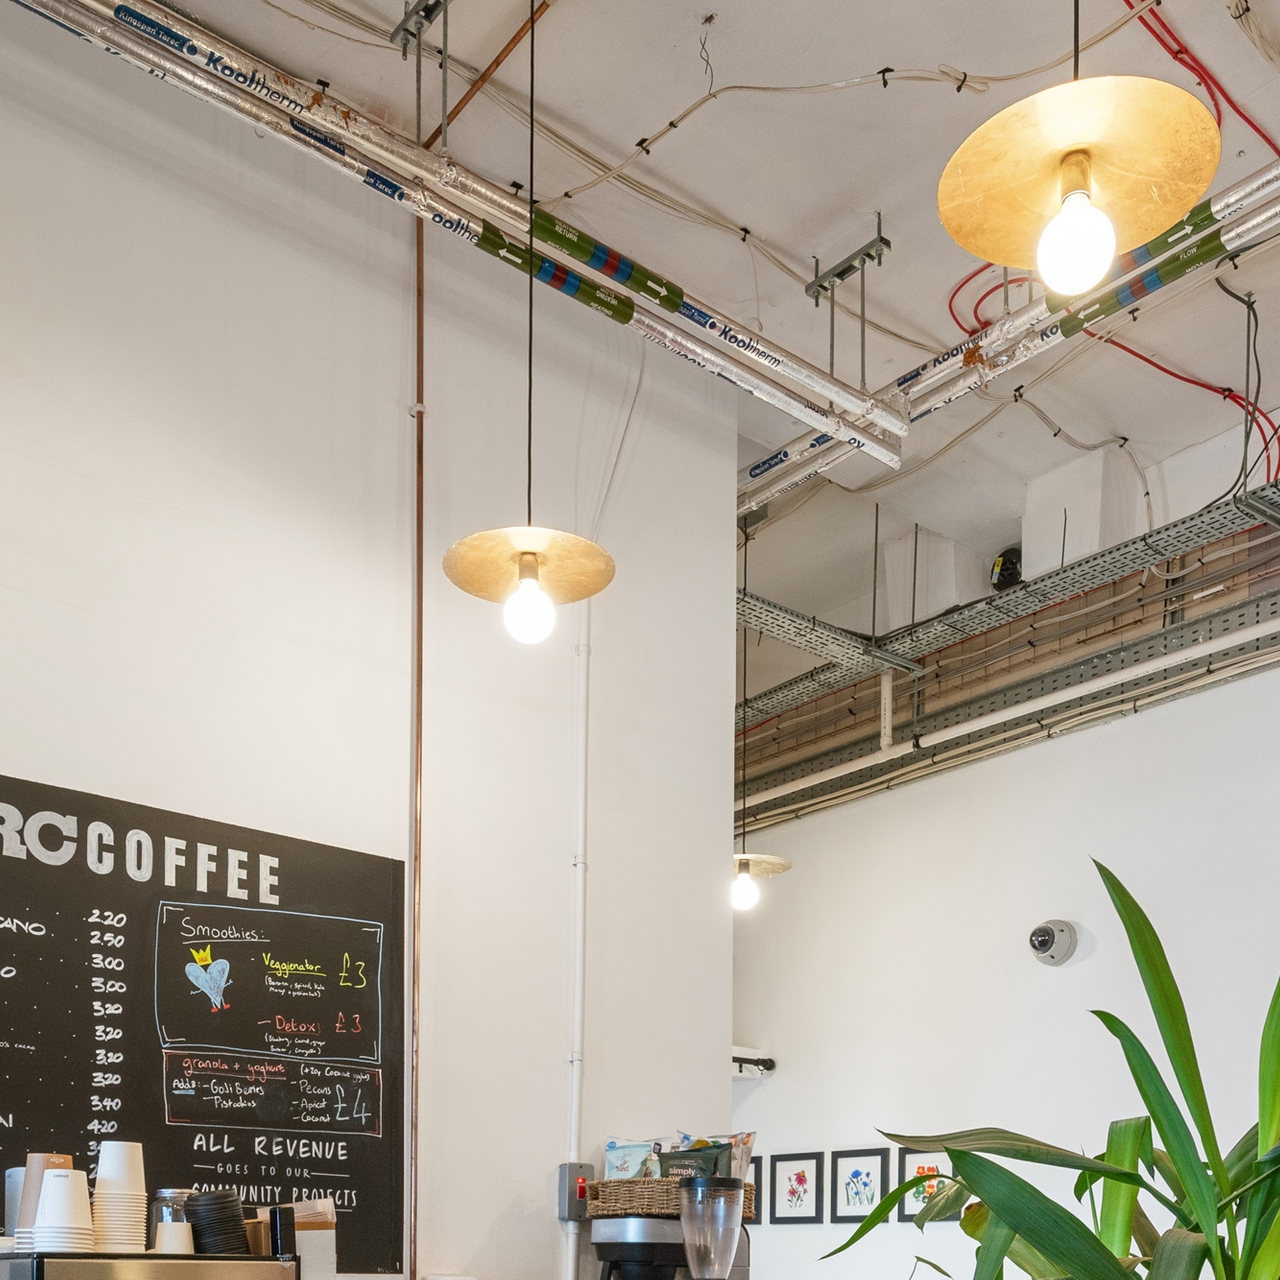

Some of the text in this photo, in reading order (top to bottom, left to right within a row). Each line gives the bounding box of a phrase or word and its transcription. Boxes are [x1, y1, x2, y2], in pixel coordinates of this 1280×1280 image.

[204, 51, 305, 114] Kooltherm
[554, 224, 577, 242] RETURN
[86, 821, 279, 905] COFFEE
[88, 910, 126, 927] 2.20
[339, 952, 367, 988] £3
[183, 1058, 285, 1082] granola yoghurt
[334, 1085, 371, 1125] £4
[193, 1133, 348, 1160] ALL REVENUE
[217, 1163, 311, 1178] GOES TO OUR
